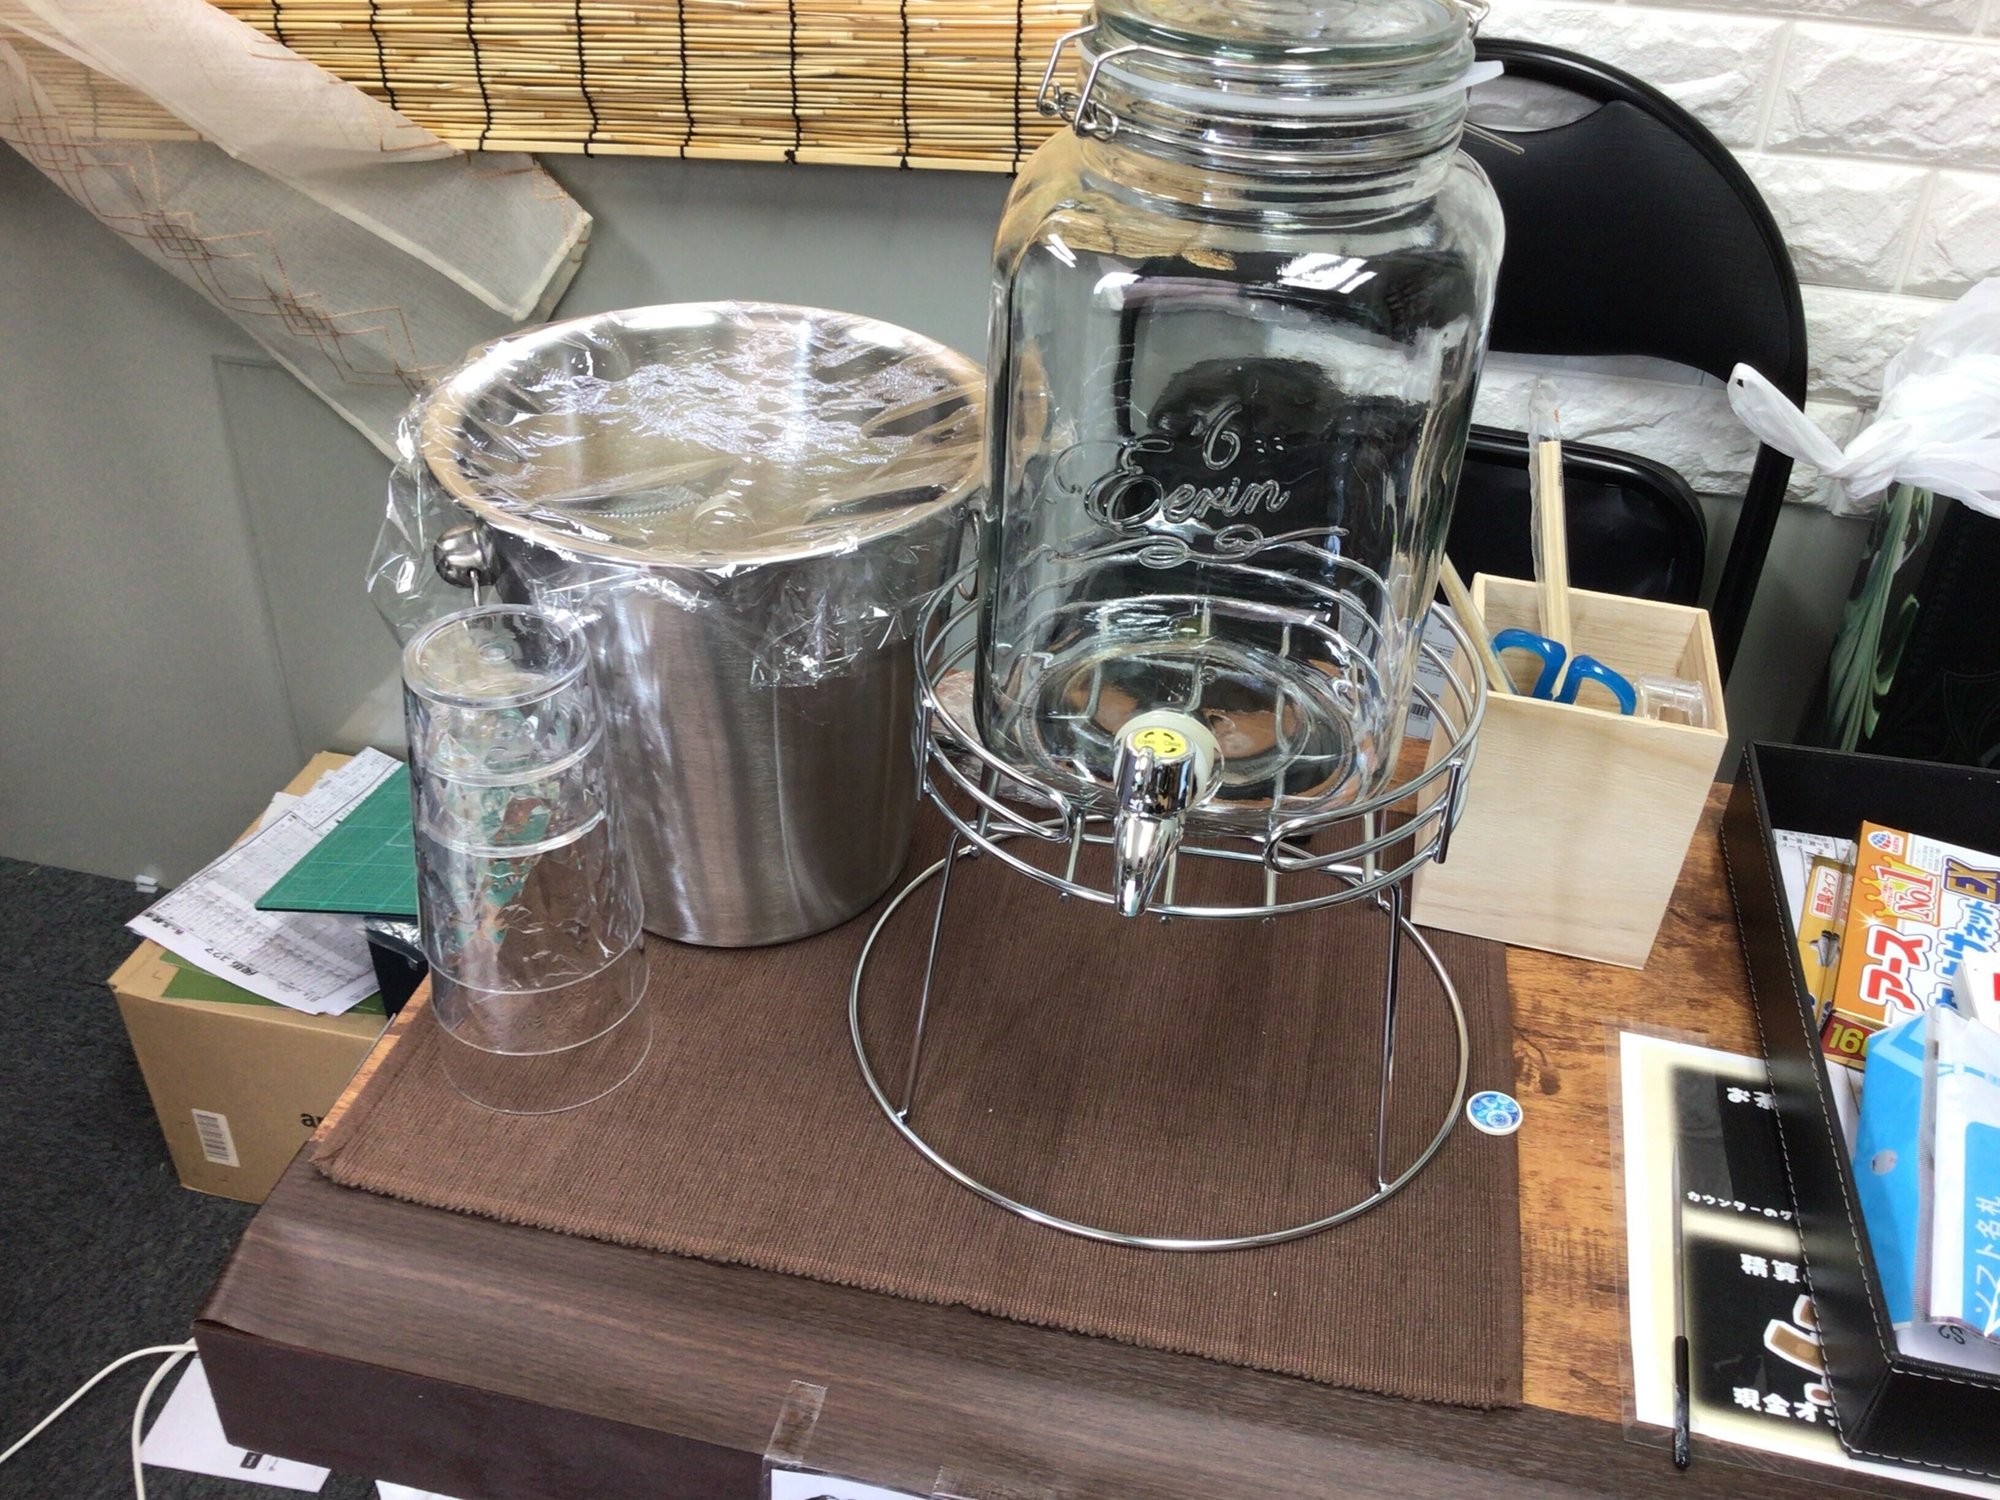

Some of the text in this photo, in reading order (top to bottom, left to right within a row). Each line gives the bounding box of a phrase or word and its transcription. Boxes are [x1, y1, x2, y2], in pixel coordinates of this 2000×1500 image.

[1877, 865, 1935, 922] No.1
[1946, 857, 1999, 902] EX
[1867, 930, 1924, 1010] アース
[1829, 1022, 1868, 1056] 16
[1740, 1253, 1805, 1284] 精算
